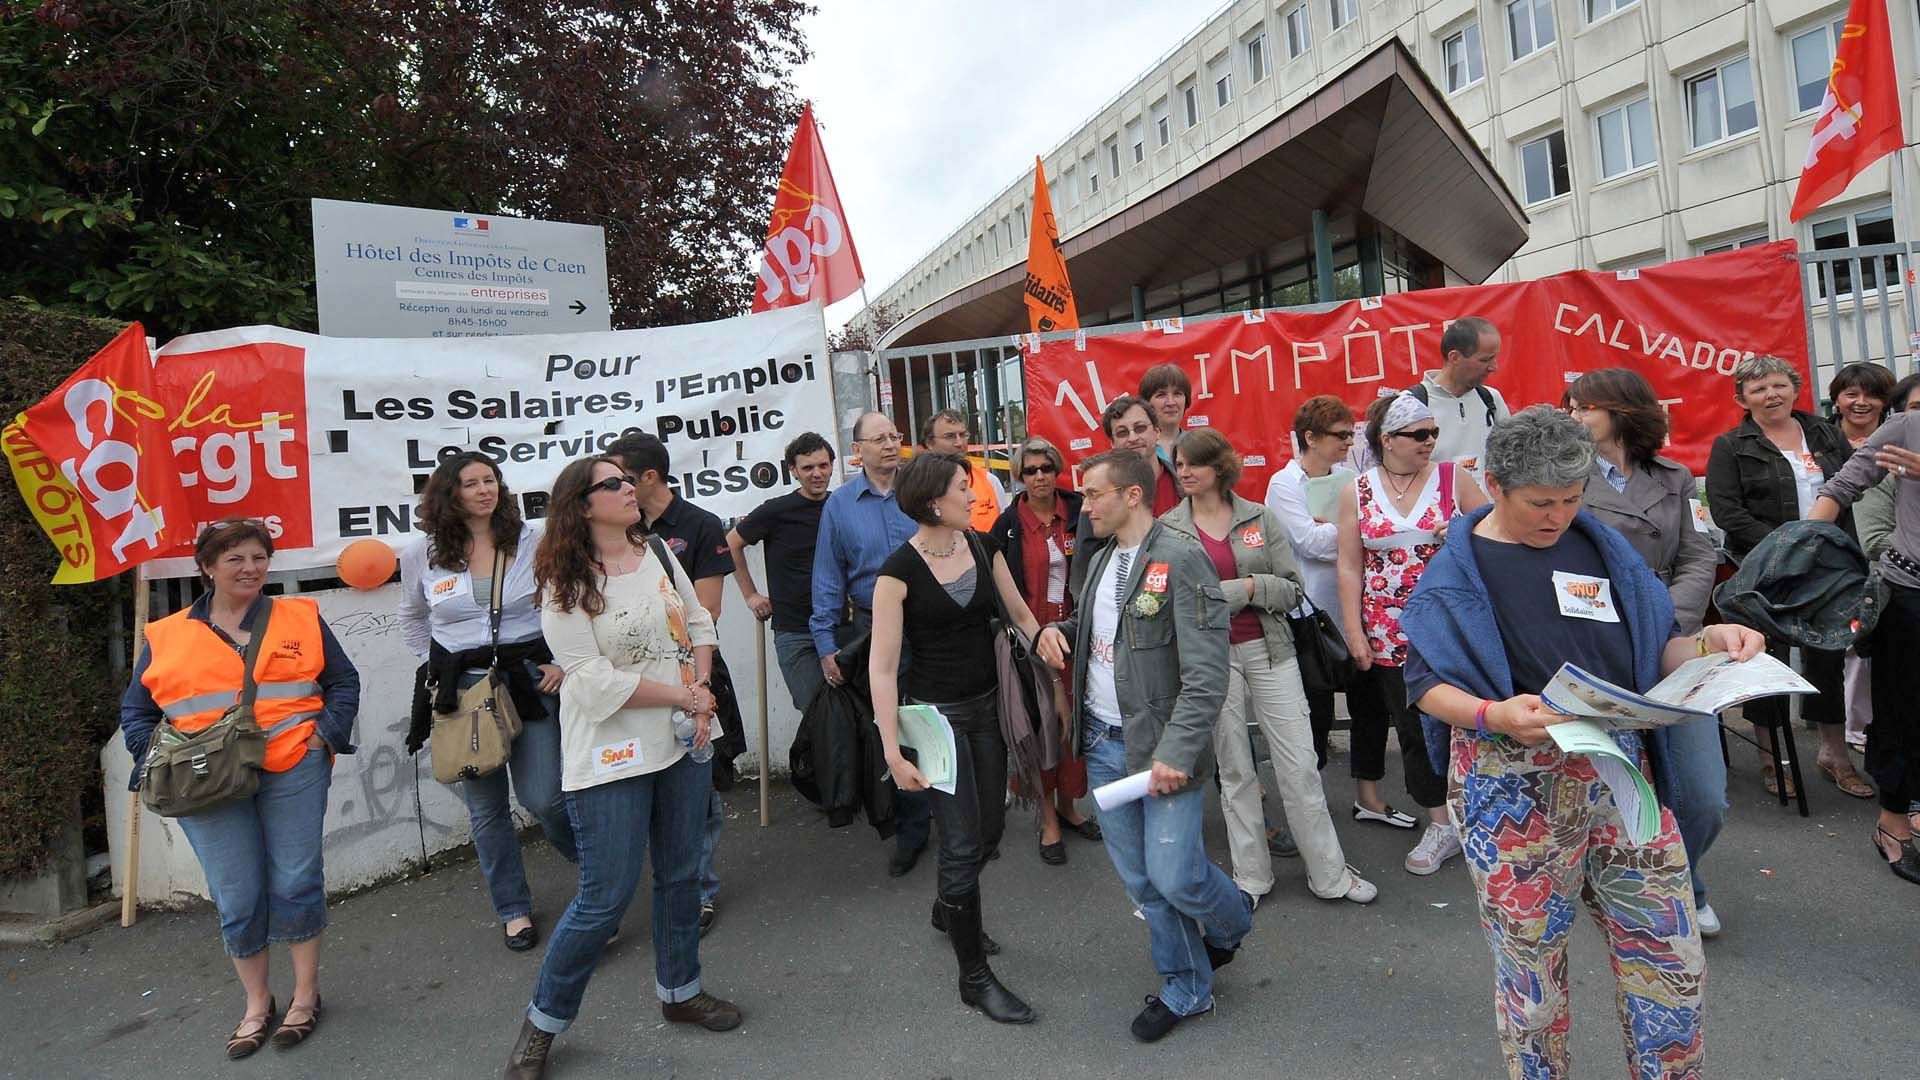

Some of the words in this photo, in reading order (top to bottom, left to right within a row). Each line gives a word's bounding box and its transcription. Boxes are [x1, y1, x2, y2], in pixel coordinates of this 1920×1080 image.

[346, 242, 402, 262] Hôtel
[409, 248, 441, 265] des
[449, 250, 512, 271] Impôts
[517, 256, 538, 271] de
[544, 257, 586, 274] Caen
[414, 266, 464, 280] Centres
[467, 270, 488, 281] des
[491, 271, 534, 285] Impôts
[399, 302, 450, 314] Réception
[456, 306, 469, 314] du
[470, 306, 493, 315] lundi
[509, 308, 549, 317] vendredi
[470, 287, 547, 301] entreprises
[1025, 272, 1067, 314] lidaires
[448, 317, 508, 327] 8h45-16h00
[545, 354, 642, 383] Pour
[1194, 316, 1457, 399] IMPÔT
[168, 371, 294, 432] la
[342, 389, 434, 421] Les
[447, 388, 644, 421] Salaires,
[655, 354, 816, 404] l'Emploi
[655, 404, 785, 443] Public
[62, 379, 166, 565] cgt
[171, 412, 299, 504] cgt
[5, 428, 91, 570] MPÔTS
[666, 460, 793, 500] ISSO
[1146, 571, 1168, 588] cgt
